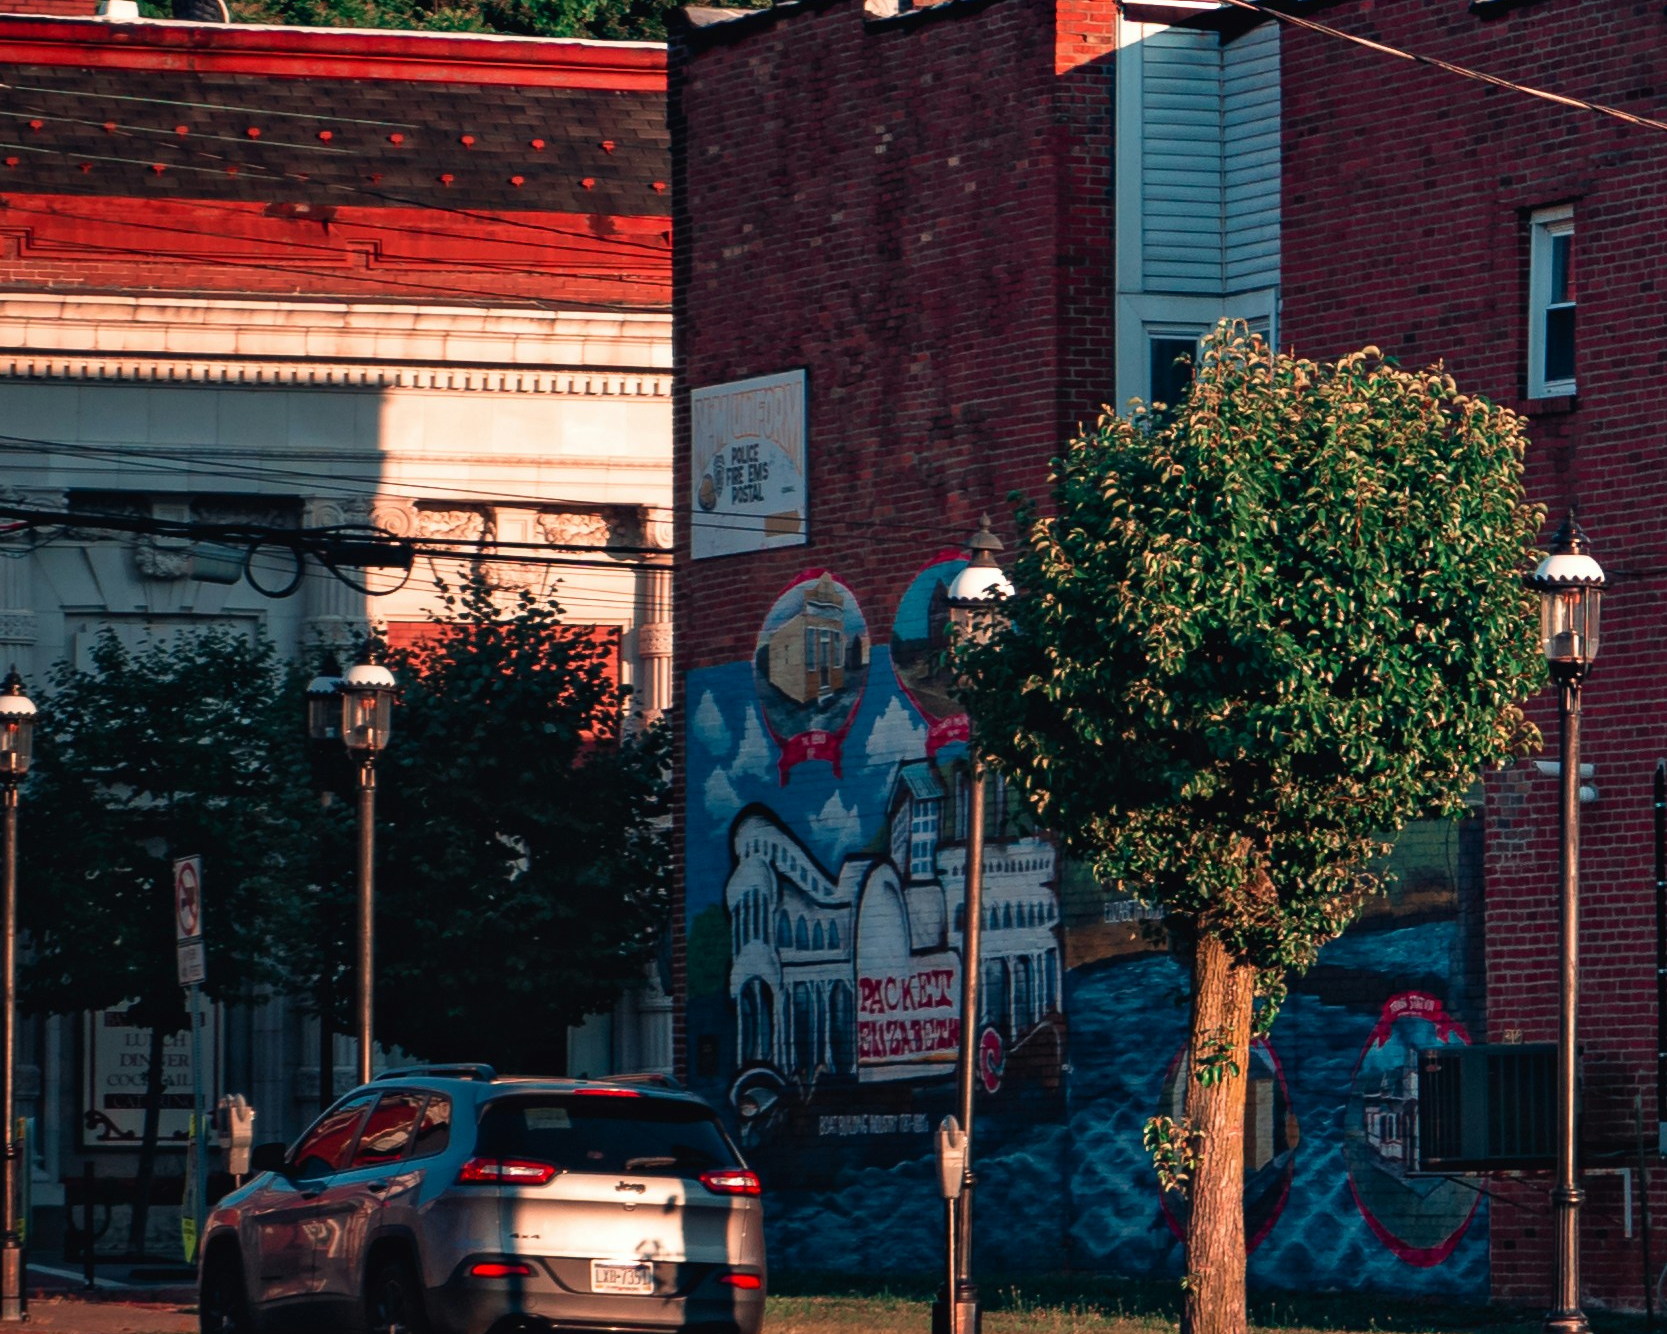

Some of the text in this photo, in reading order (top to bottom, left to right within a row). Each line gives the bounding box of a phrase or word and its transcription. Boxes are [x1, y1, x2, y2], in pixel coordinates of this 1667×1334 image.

[732, 444, 760, 465] POLICE
[726, 462, 769, 486] FIRE EMS
[732, 483, 764, 505] POSTAL
[859, 969, 954, 1014] PACKET
[126, 1033, 188, 1047] LUH
[120, 1053, 190, 1067] DINER
